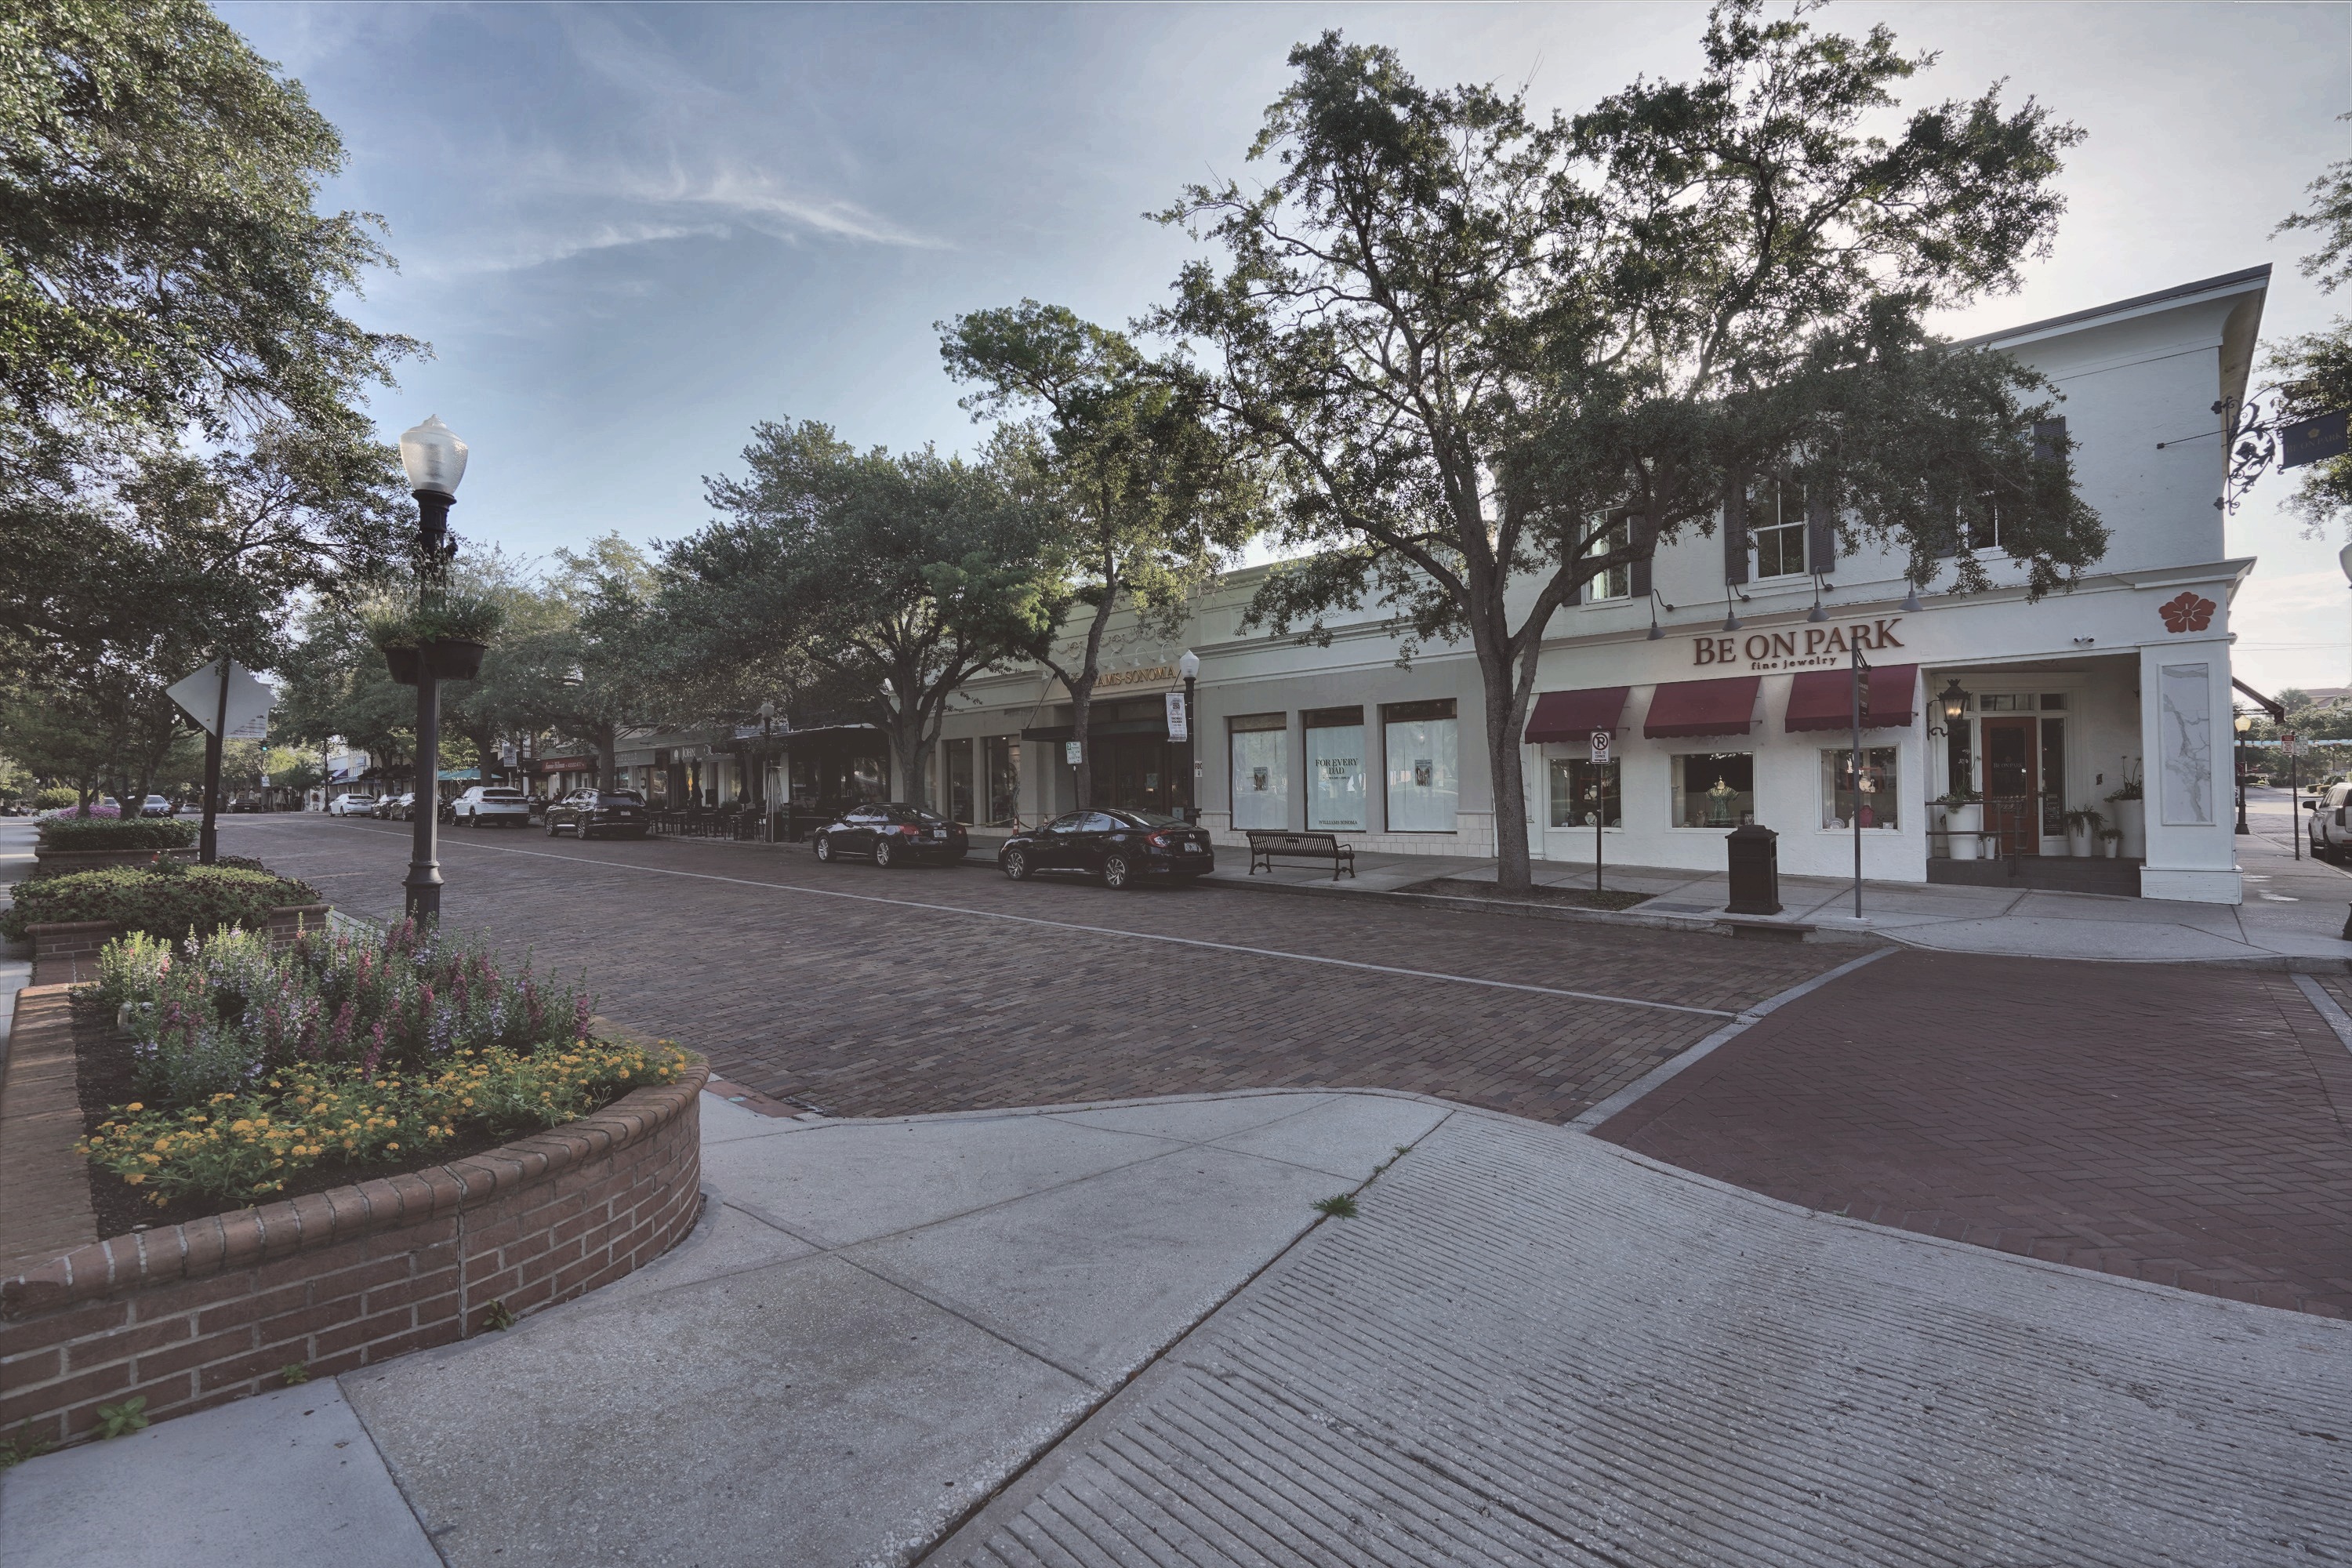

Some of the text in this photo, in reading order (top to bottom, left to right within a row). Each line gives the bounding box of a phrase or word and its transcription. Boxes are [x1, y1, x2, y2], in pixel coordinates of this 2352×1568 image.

[1693, 618, 1905, 666] BE ON PARK
[1751, 656, 1838, 670] fine jewelry
[1093, 665, 1176, 688] AMS-SONOMA
[1315, 758, 1359, 768] FOR EVERY
